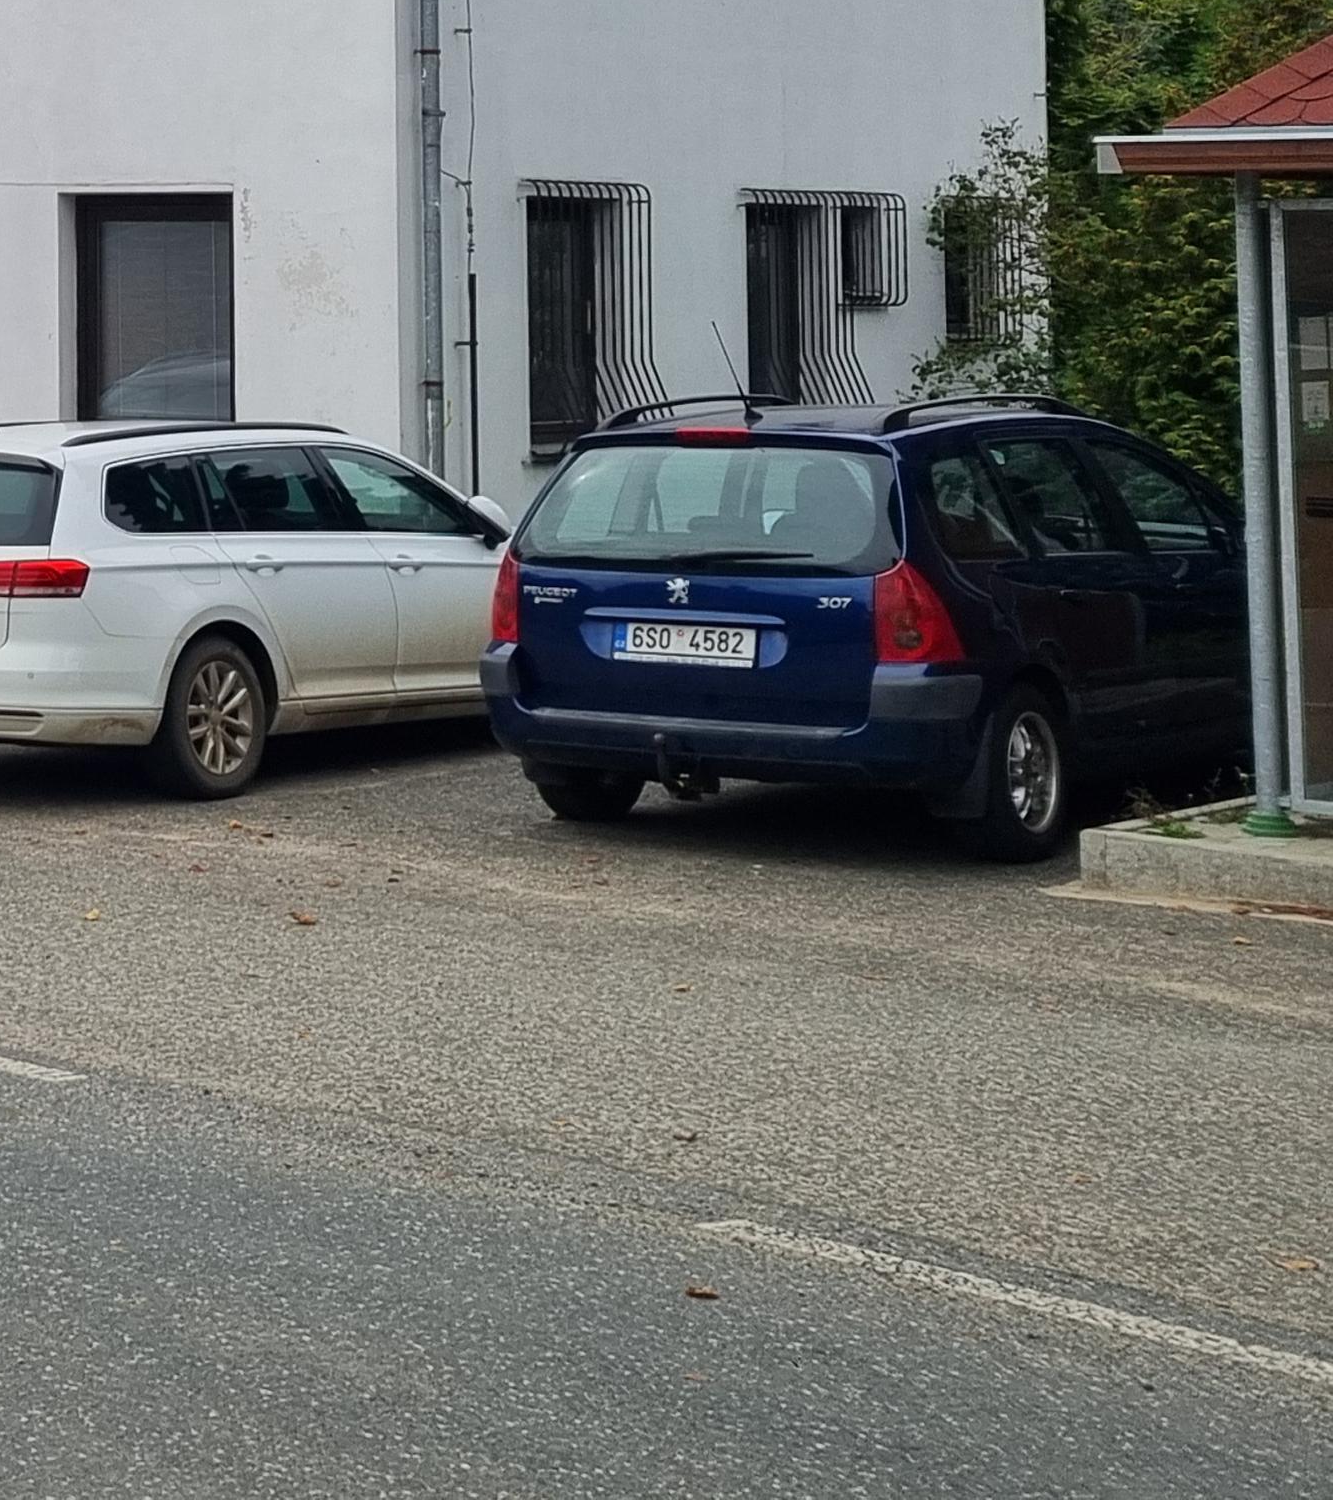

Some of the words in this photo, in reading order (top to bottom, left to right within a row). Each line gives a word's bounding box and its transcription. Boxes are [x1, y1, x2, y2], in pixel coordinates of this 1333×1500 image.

[523, 585, 578, 598] PEUGEOT
[816, 596, 852, 609] 307
[689, 629, 744, 654] 4582
